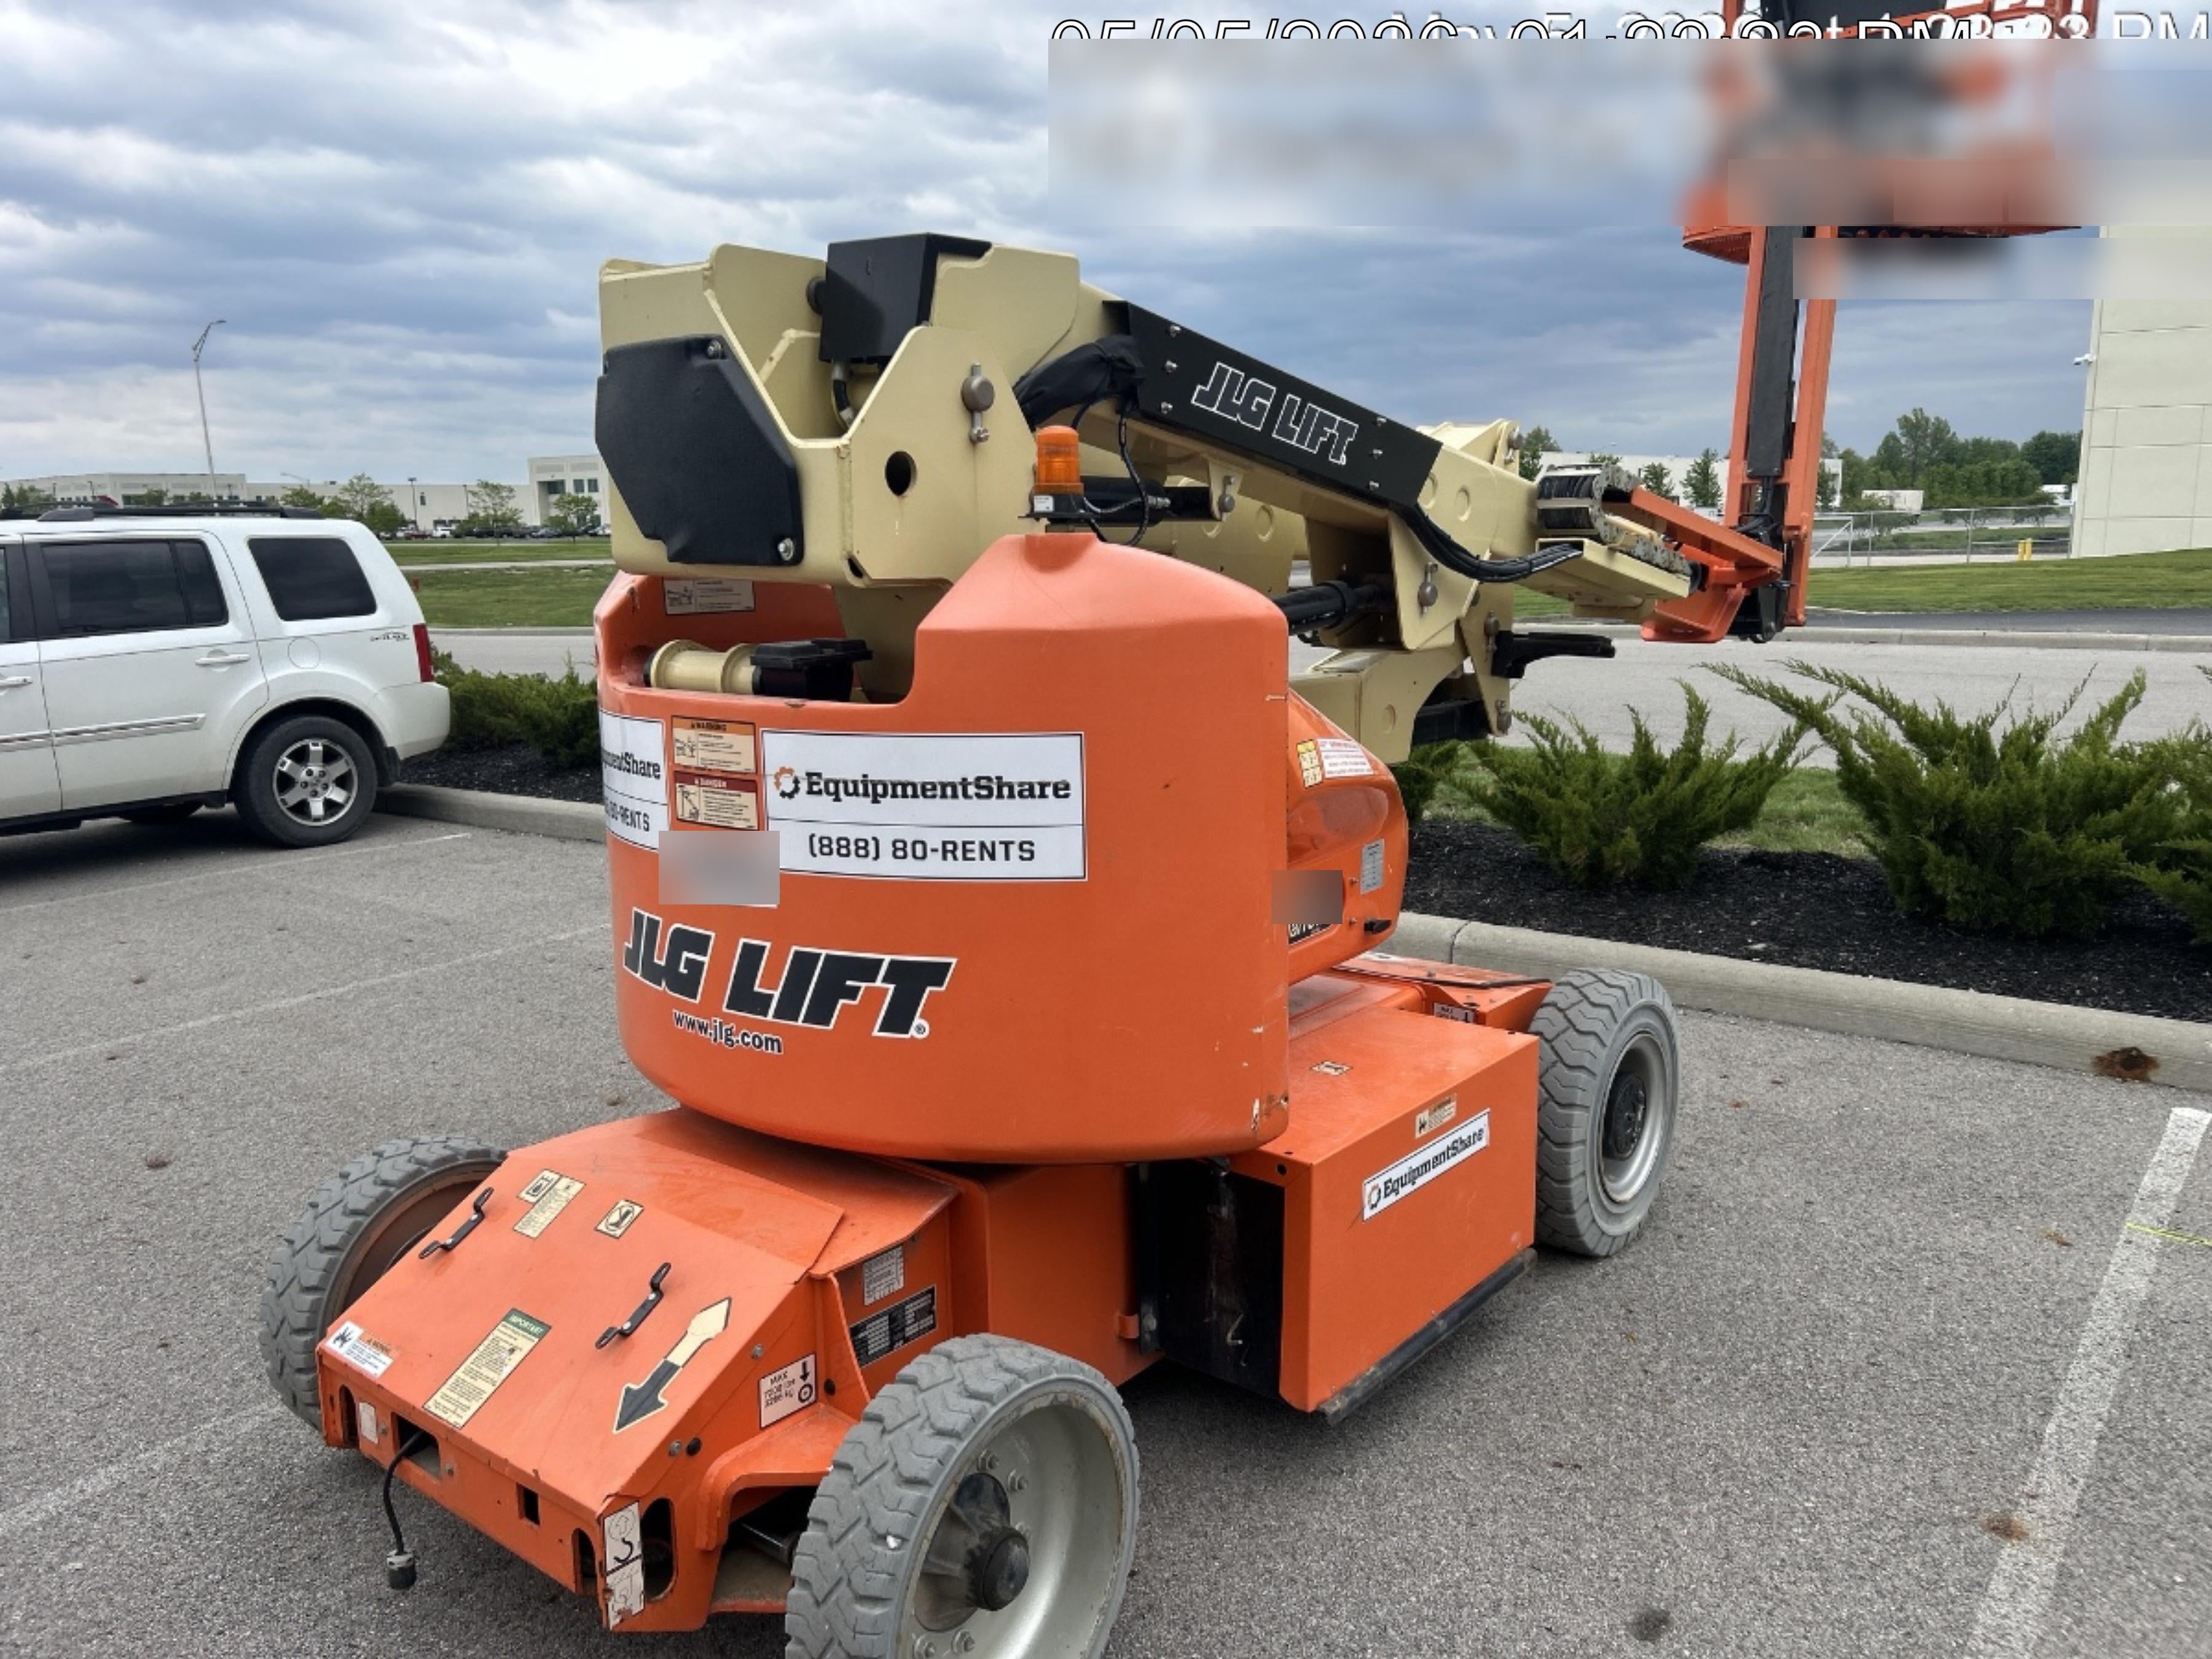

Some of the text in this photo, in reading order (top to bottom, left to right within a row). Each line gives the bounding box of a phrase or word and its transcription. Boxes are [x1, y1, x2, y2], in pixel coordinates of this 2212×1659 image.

[1191, 361, 1359, 465] JLG LIFT
[805, 772, 1071, 804] EquipmentShare
[809, 833, 1035, 861] (888) 80-RENTS
[622, 907, 716, 1003] JLG
[673, 1010, 783, 1055] www.jlg.com
[1384, 1128, 1484, 1199] EquipmentShare
